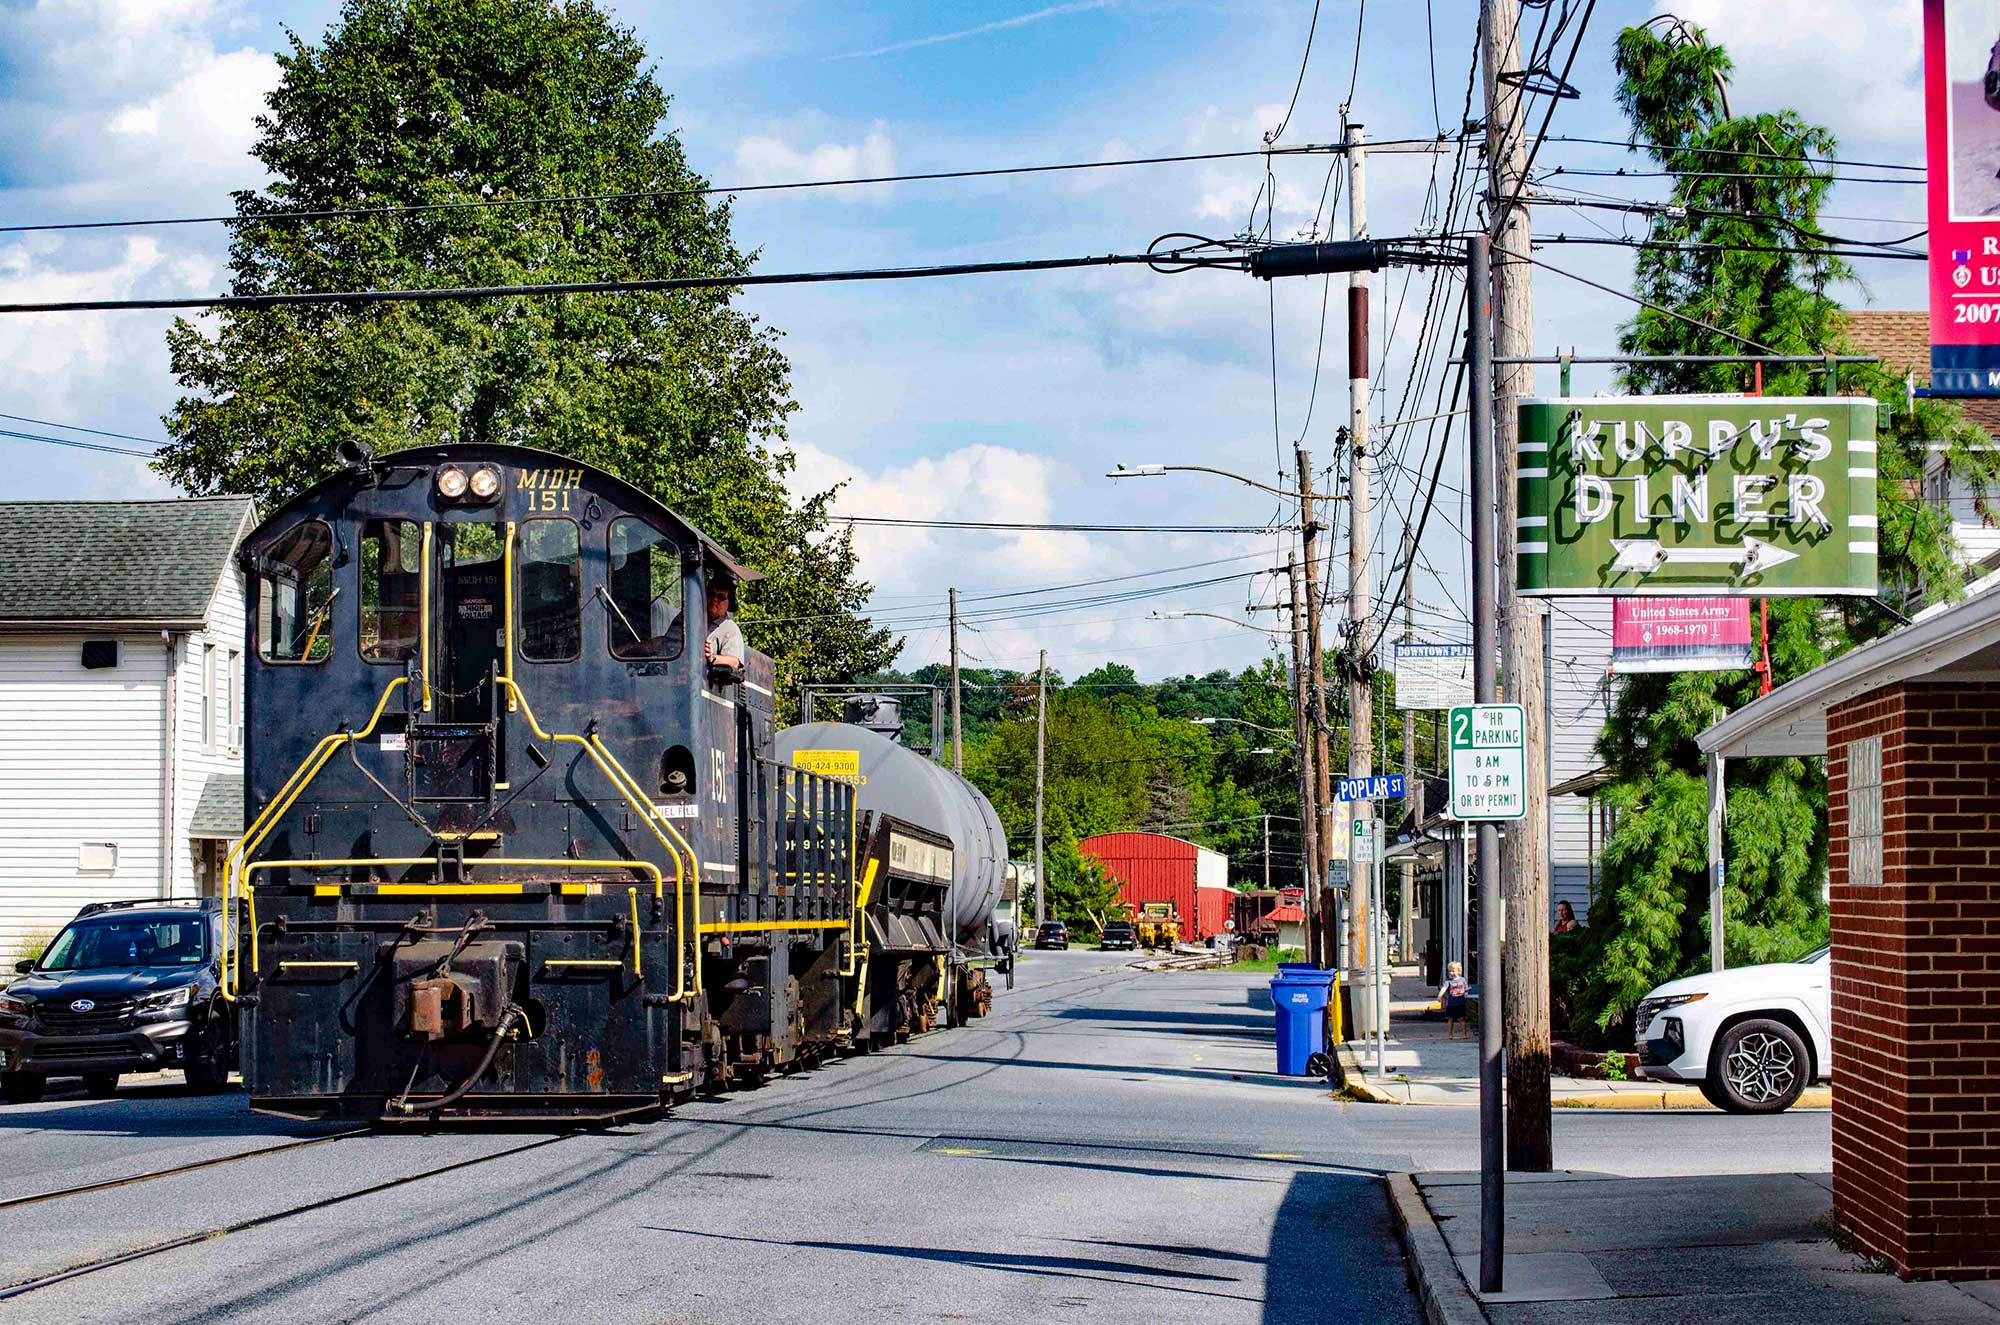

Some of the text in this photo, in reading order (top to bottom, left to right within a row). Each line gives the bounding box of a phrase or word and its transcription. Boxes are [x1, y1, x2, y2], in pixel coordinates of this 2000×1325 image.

[1980, 266, 2000, 286] U
[517, 468, 584, 490] MIDH
[528, 491, 570, 512] 151
[1575, 474, 1830, 524] DINER
[1632, 605, 1731, 618] United States Army
[1656, 623, 1708, 636] 1968-1970
[1397, 646, 1449, 657] DOWNTOWN
[1454, 711, 1504, 745] 2 HR
[1475, 730, 1519, 745] PARKING
[1475, 755, 1500, 768] 8 AM
[711, 747, 727, 804] 151
[1467, 775, 1478, 788] TO
[1496, 775, 1509, 788] PM
[1340, 777, 1401, 800] POPLAR ST
[1461, 793, 1517, 808] OR BY PERMIT
[1355, 821, 1362, 835] 2
[1329, 861, 1335, 871] 2
